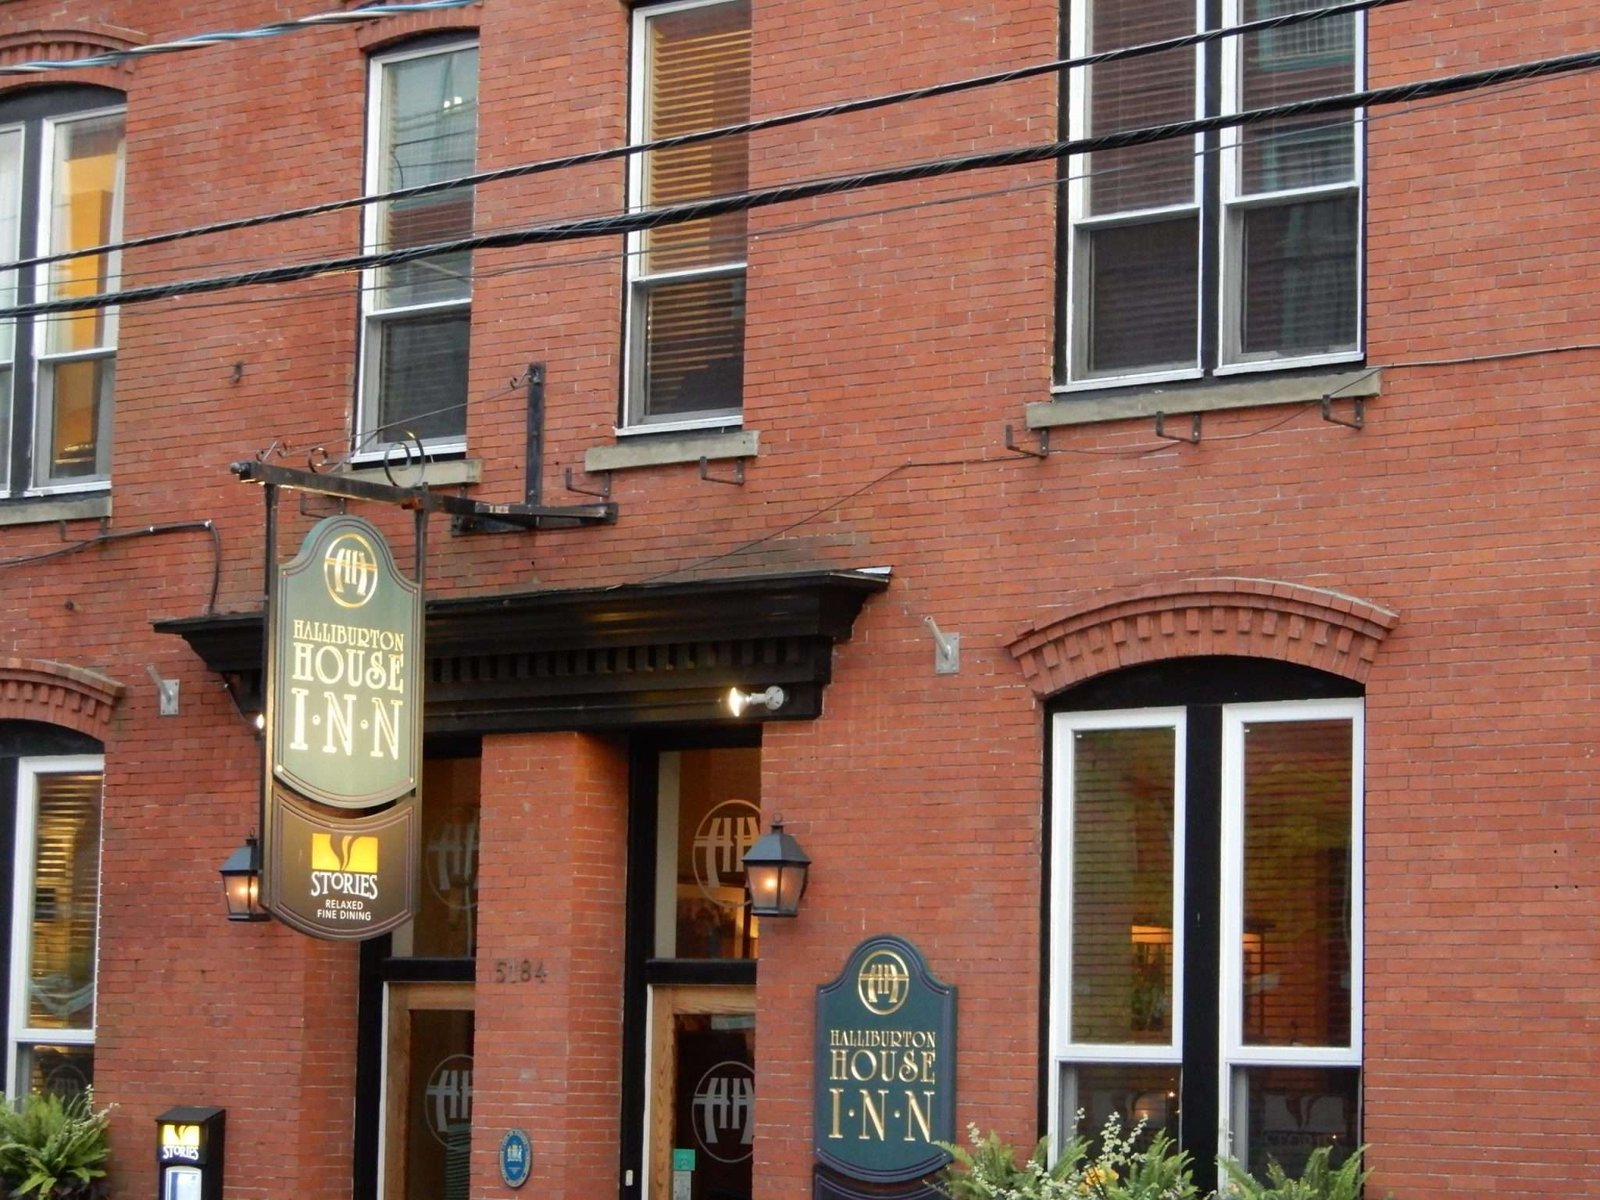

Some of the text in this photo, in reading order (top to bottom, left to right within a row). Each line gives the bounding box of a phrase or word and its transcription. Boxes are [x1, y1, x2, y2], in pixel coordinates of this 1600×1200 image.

[293, 619, 404, 652] HALLIBURTON
[292, 642, 404, 694] HOUSE
[311, 871, 378, 900] STORIES
[317, 909, 372, 921] FINE DINING
[325, 899, 364, 910] RELAXED
[495, 959, 547, 984] 5184
[830, 1030, 936, 1048] HALLIBURTON
[829, 1049, 936, 1084] HOUSE
[163, 1145, 199, 1160] STORIES
